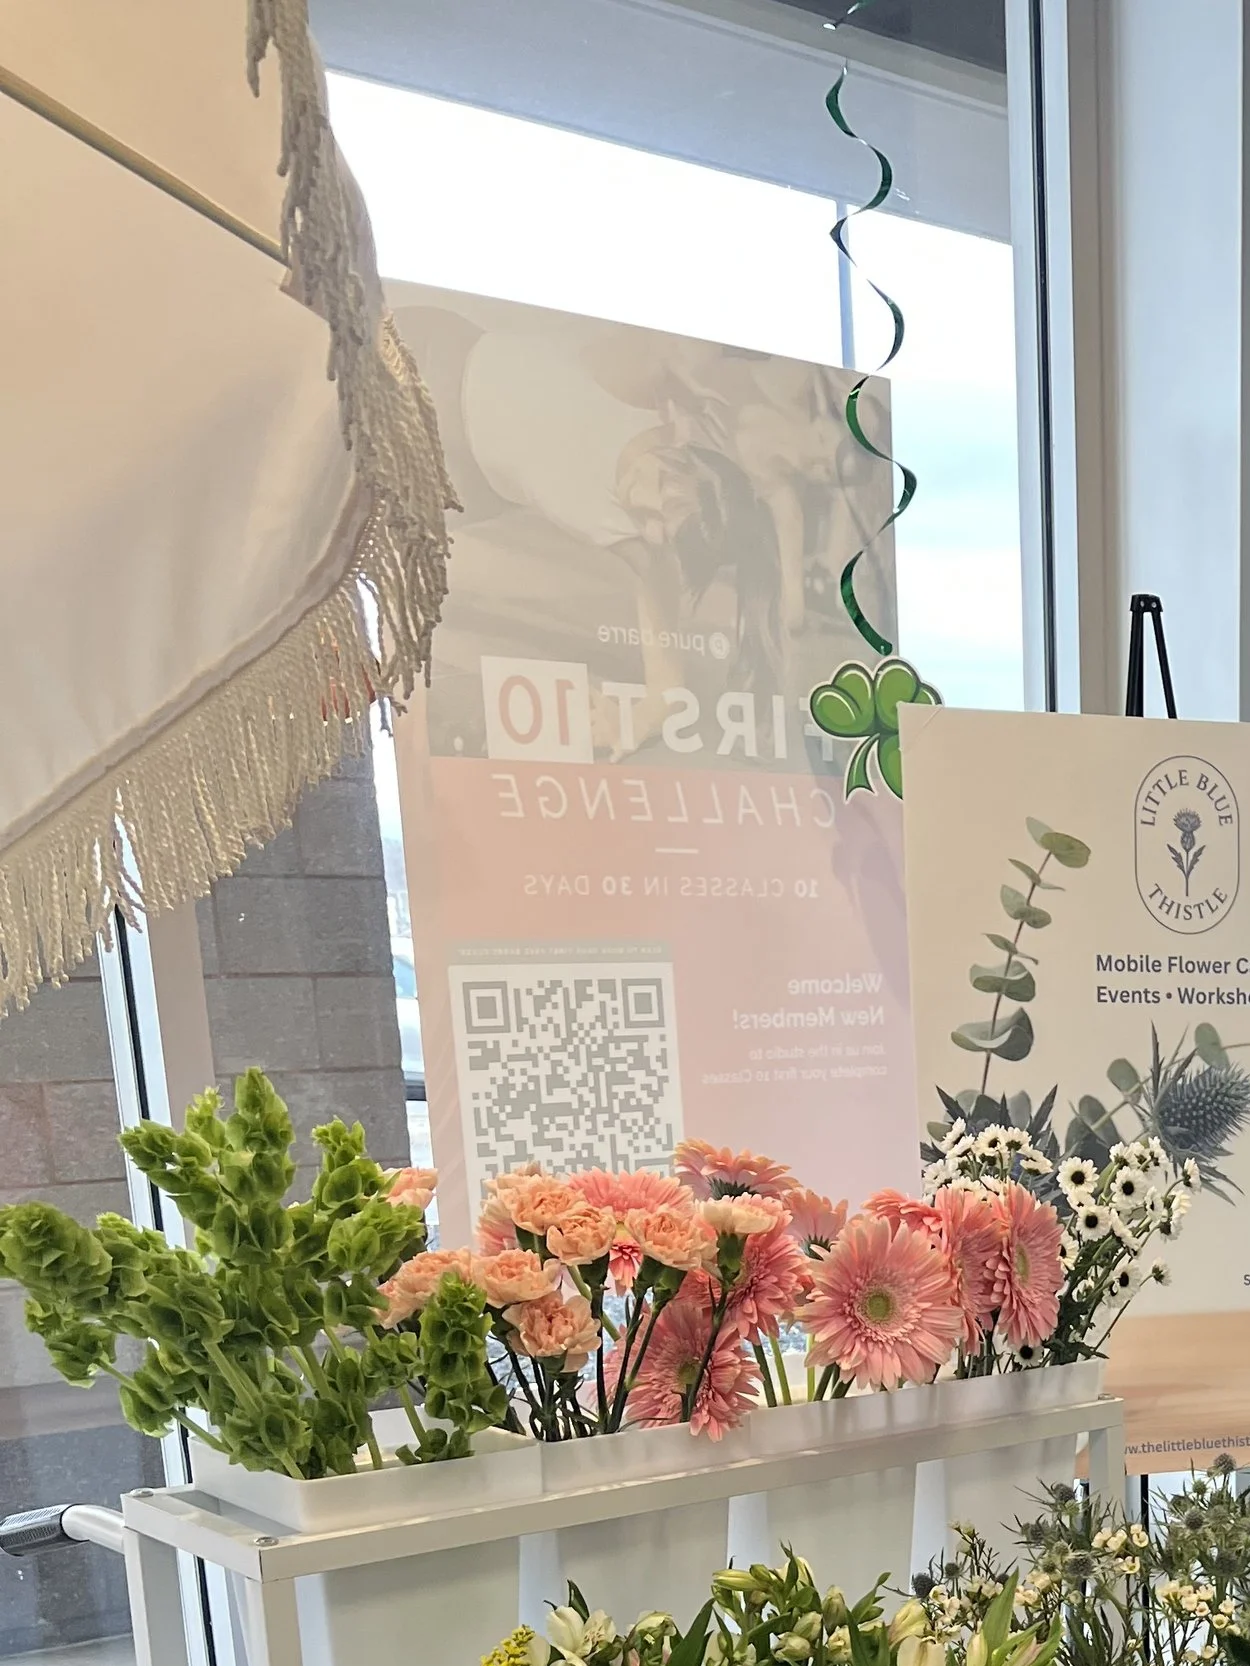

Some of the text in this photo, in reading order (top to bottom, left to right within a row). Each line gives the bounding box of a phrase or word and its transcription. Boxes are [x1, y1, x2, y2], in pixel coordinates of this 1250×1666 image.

[1140, 769, 1234, 827] LITTLE BLUE
[1148, 882, 1228, 921] THISTLE
[1095, 954, 1163, 973] Mobile
[1167, 955, 1232, 974] Flower
[1096, 985, 1161, 1004] Events
